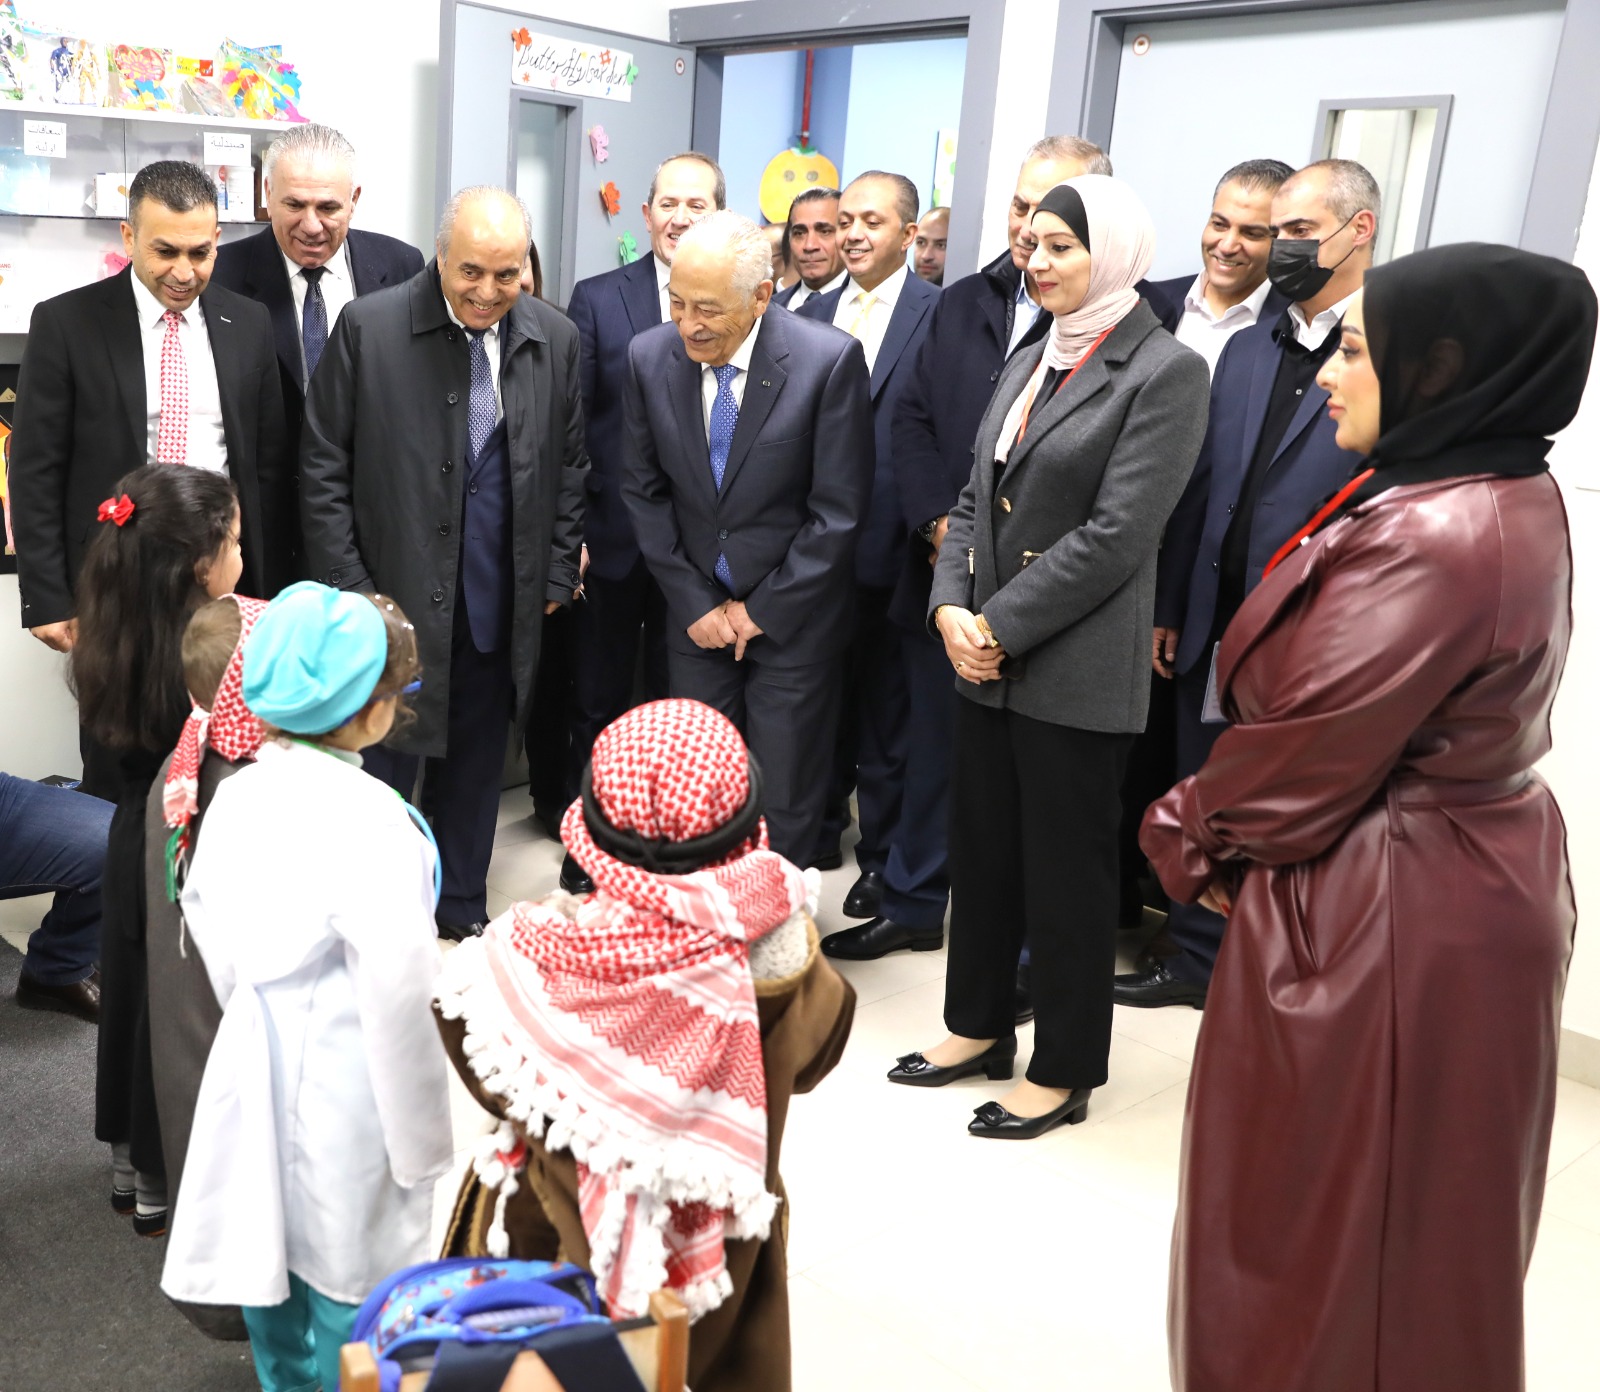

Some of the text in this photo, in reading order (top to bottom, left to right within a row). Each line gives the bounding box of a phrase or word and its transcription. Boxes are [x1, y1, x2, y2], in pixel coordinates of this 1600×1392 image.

[518, 45, 630, 86] Butterfly Garden
[210, 135, 245, 151] صيدلية
